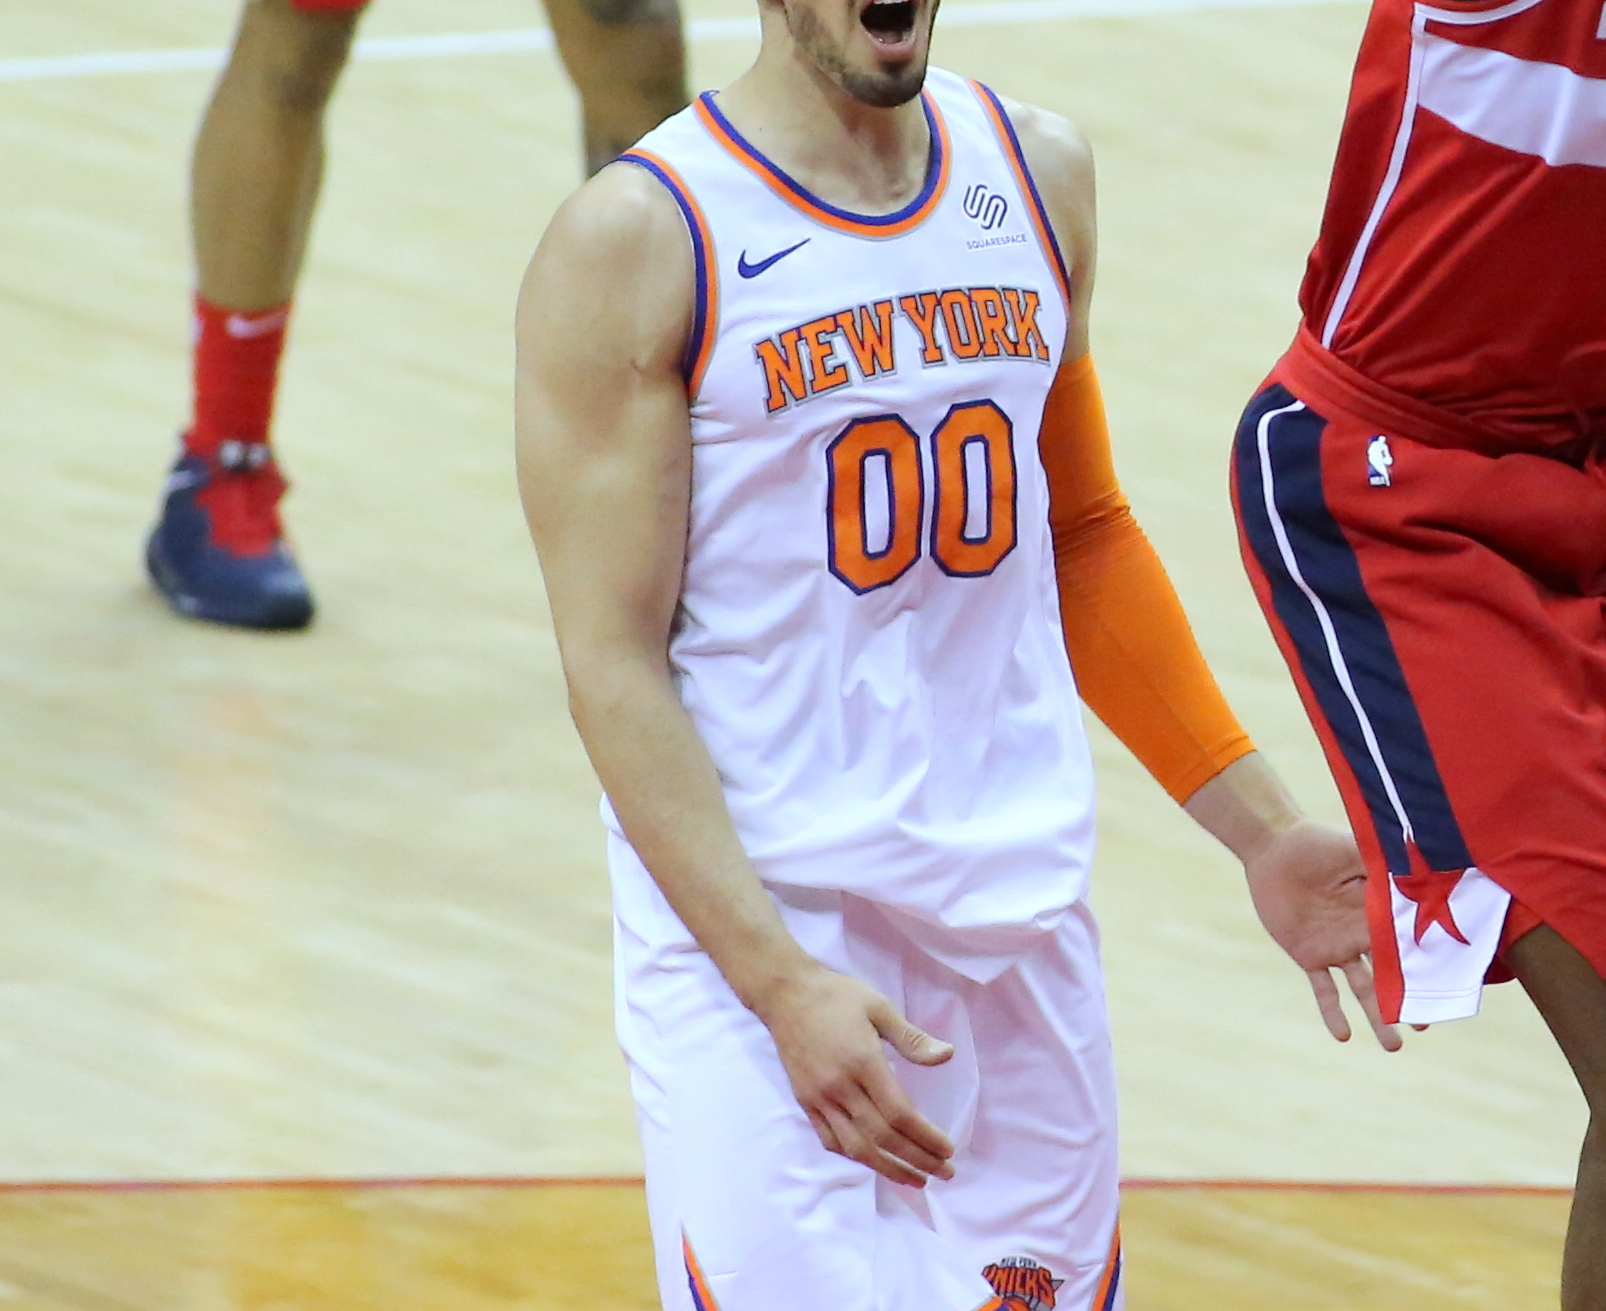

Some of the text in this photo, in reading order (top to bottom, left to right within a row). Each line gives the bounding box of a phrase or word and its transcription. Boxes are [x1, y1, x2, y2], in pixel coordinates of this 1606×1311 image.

[966, 234, 1028, 250] SQUARESPACE
[753, 285, 1051, 418] NEW YORK
[825, 398, 1018, 596] 00
[981, 1263, 1056, 1308] KNICKS
